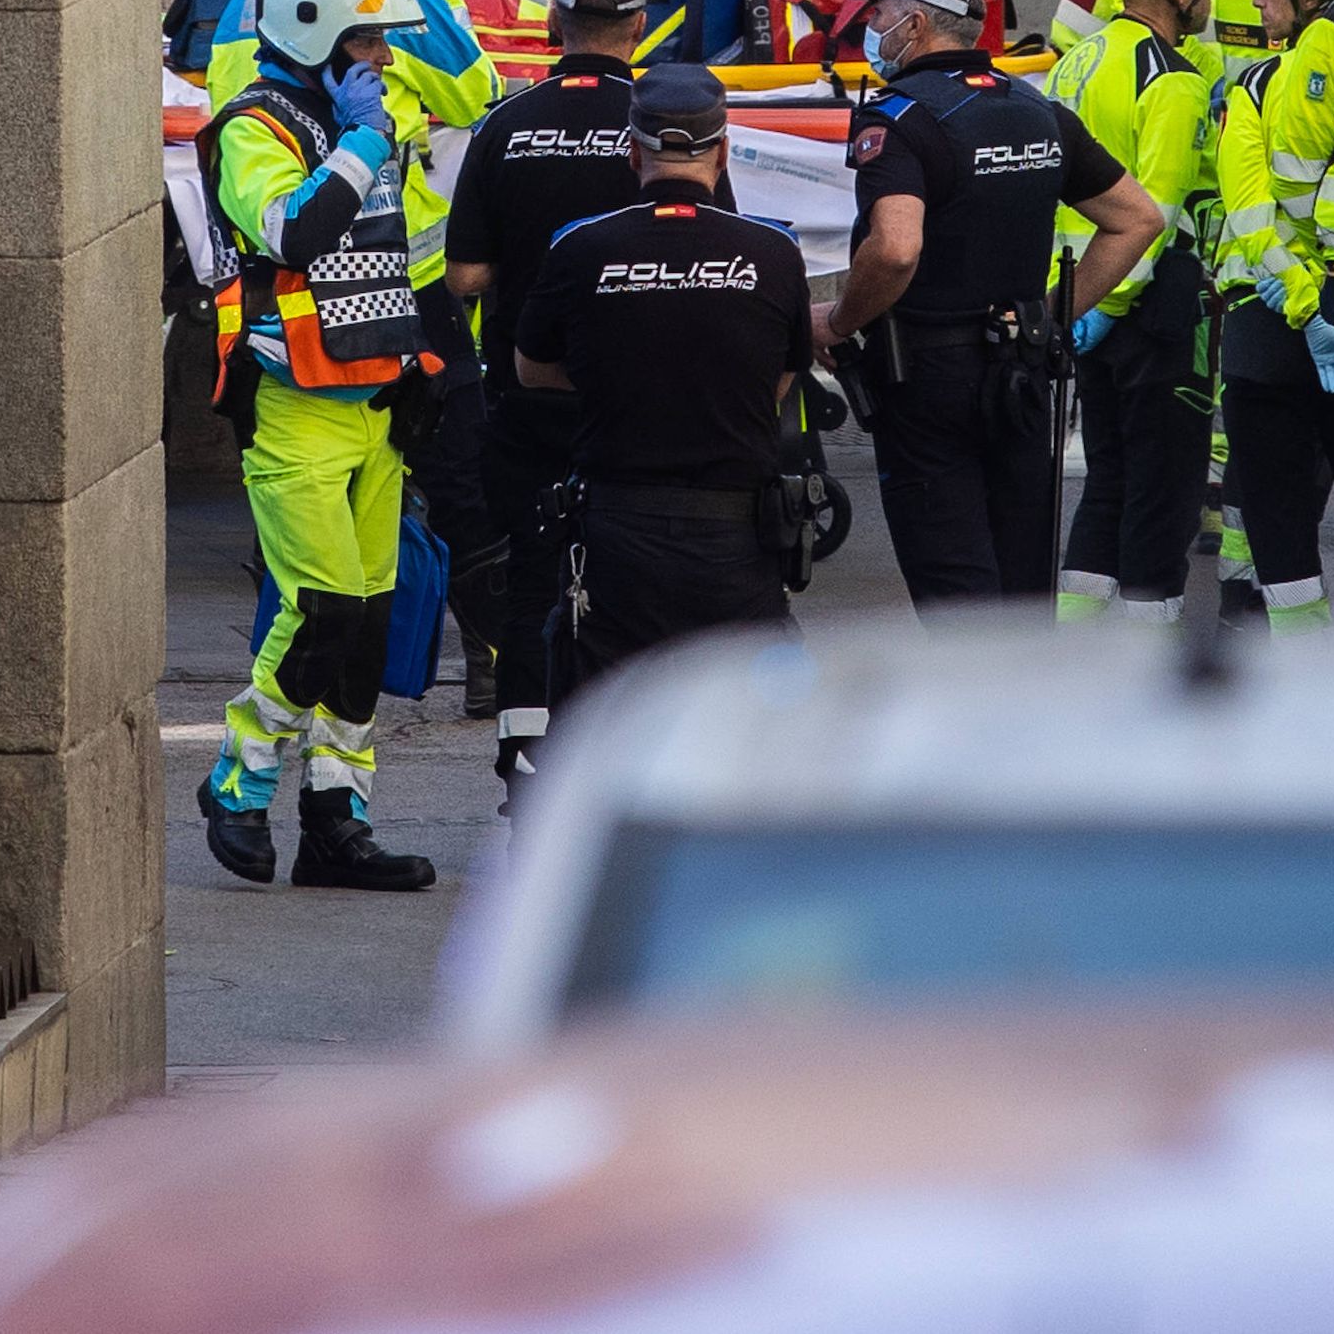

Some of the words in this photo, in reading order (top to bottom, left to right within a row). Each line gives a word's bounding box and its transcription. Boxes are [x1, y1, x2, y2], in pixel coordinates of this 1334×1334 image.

[573, 146, 632, 157] MADRI
[974, 139, 1063, 165] POLICÍA
[598, 255, 759, 284] POLICÍA
[595, 282, 677, 295] MUNICIPAL
[678, 278, 757, 291] MADRID
